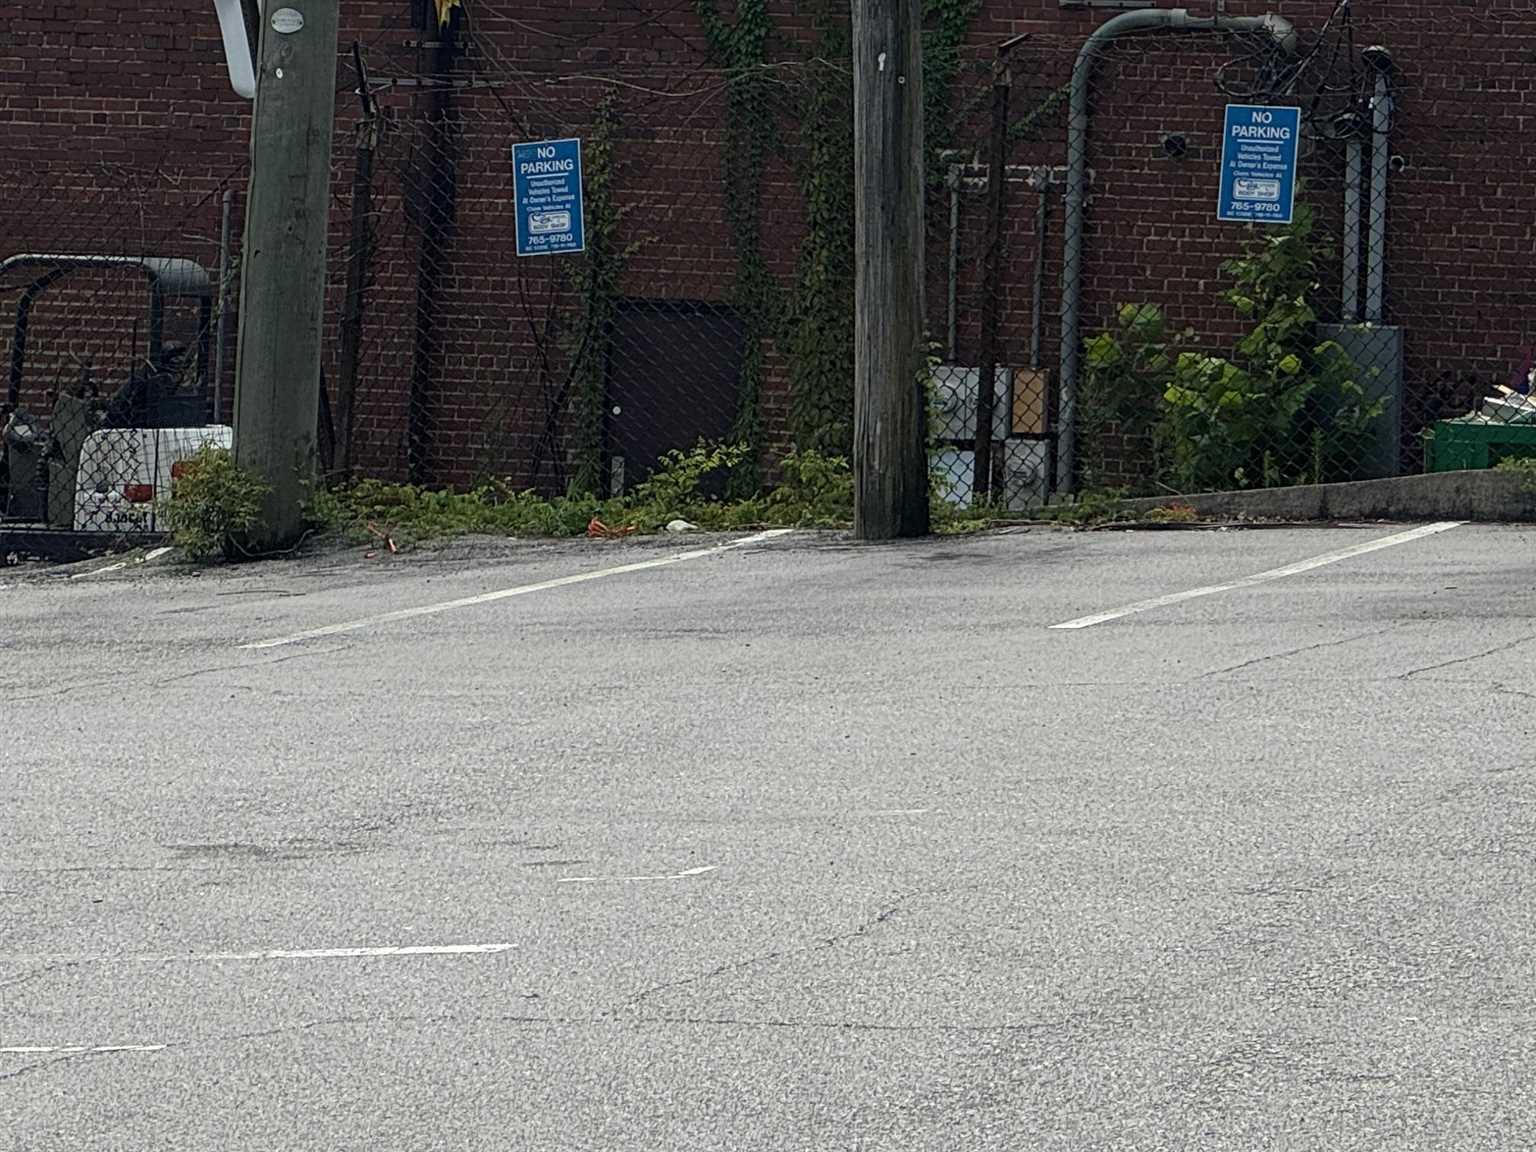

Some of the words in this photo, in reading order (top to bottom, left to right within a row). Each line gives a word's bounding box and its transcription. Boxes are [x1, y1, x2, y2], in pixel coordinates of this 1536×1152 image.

[1251, 111, 1273, 124] NO
[1231, 125, 1291, 139] PARKING
[537, 146, 556, 159] NO
[520, 158, 574, 175] PARKING
[1230, 201, 1281, 212] 765-9780
[528, 233, 573, 245] 765-9780
